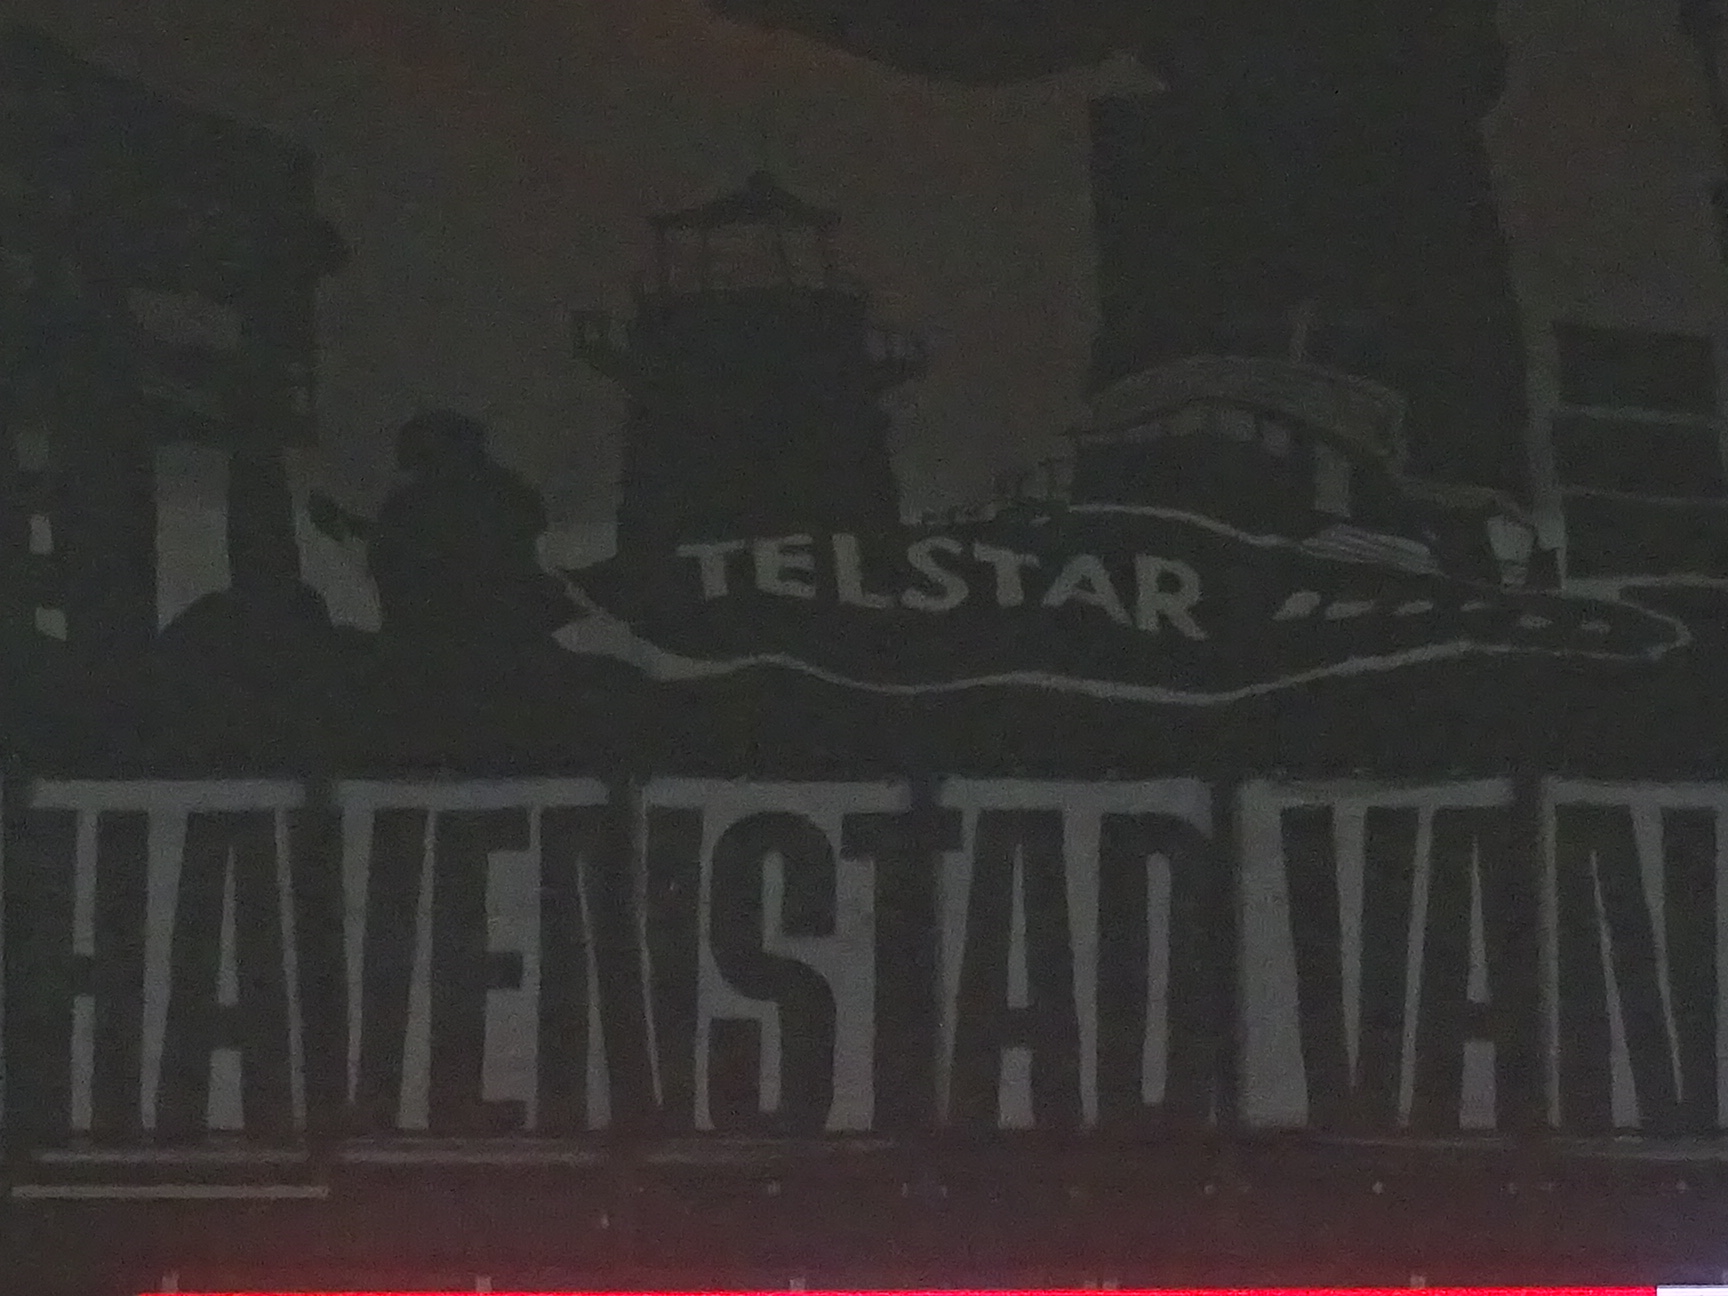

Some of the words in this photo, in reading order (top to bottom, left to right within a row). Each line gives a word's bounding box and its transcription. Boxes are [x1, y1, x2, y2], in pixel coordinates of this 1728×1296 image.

[674, 531, 1207, 642] TELSTAR
[0, 804, 1214, 1132] HAVENSTAD
[1278, 802, 1718, 1130] VAN
